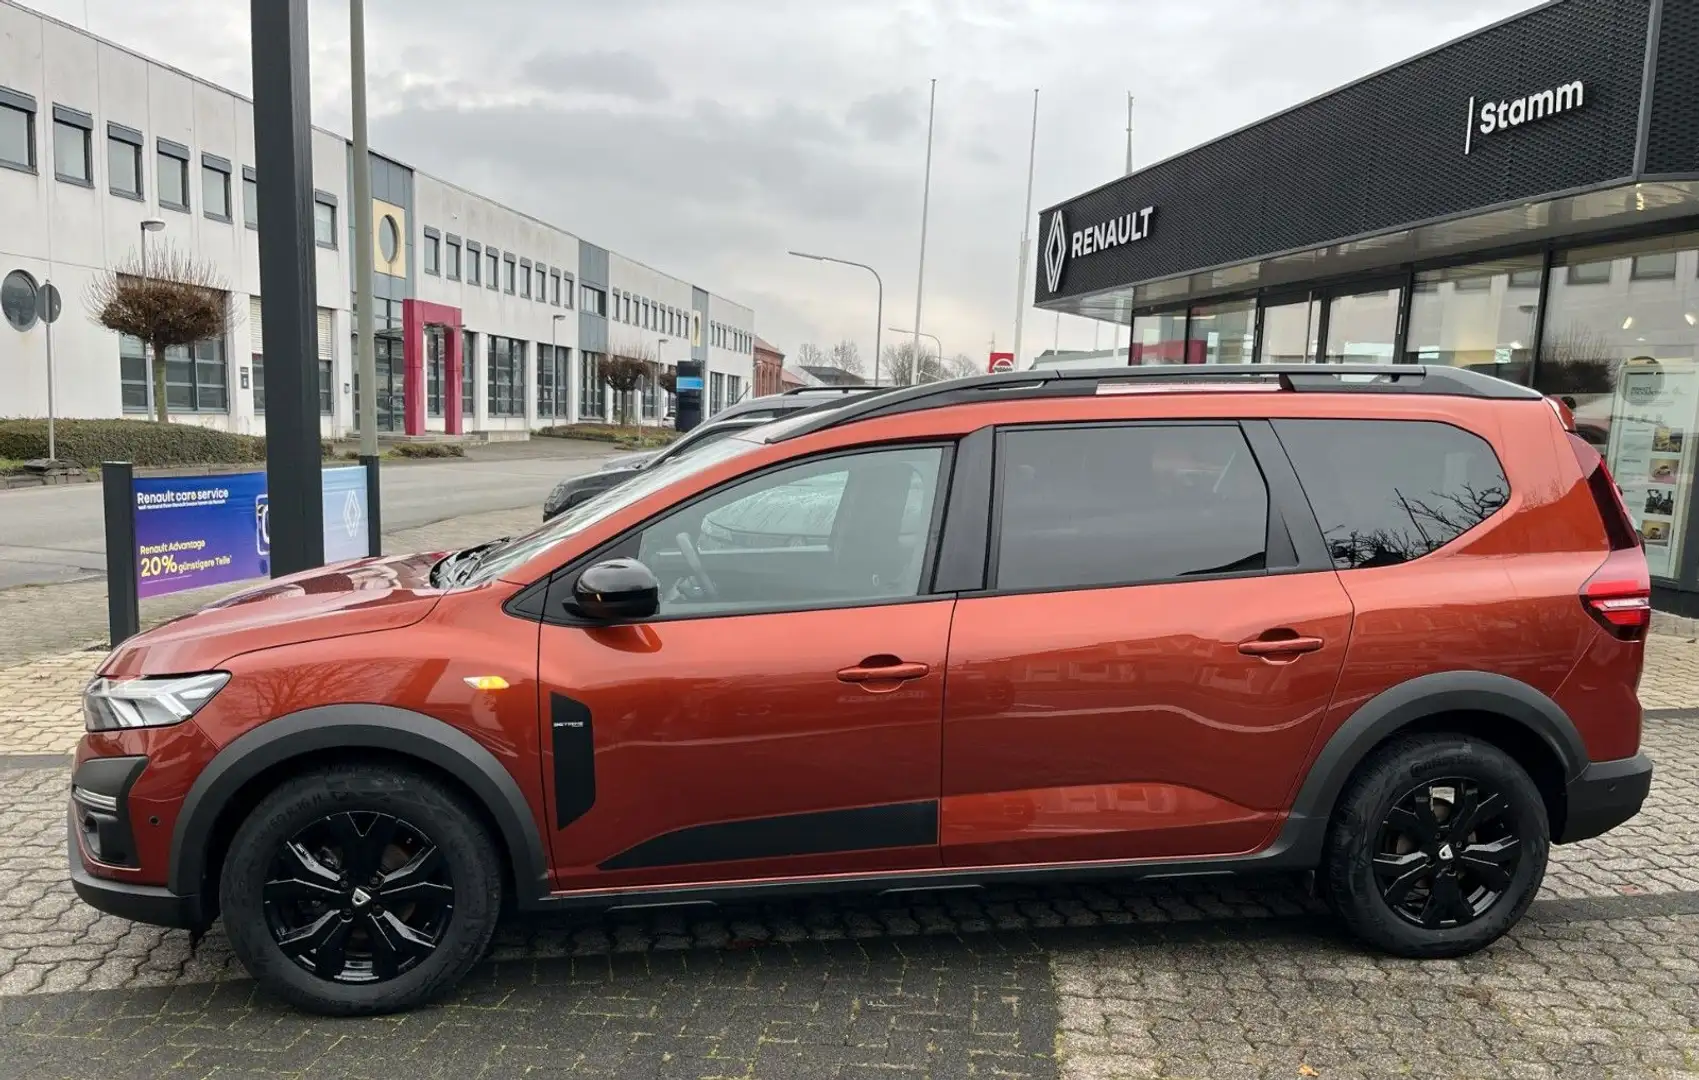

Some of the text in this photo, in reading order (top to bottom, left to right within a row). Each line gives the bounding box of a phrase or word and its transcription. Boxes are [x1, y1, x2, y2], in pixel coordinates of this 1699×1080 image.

[1479, 79, 1584, 134] Stamm
[1071, 206, 1155, 259] RENAULT
[137, 488, 229, 504] Renault care service
[140, 540, 205, 554] Renault Advantage
[141, 555, 177, 577] 20%
